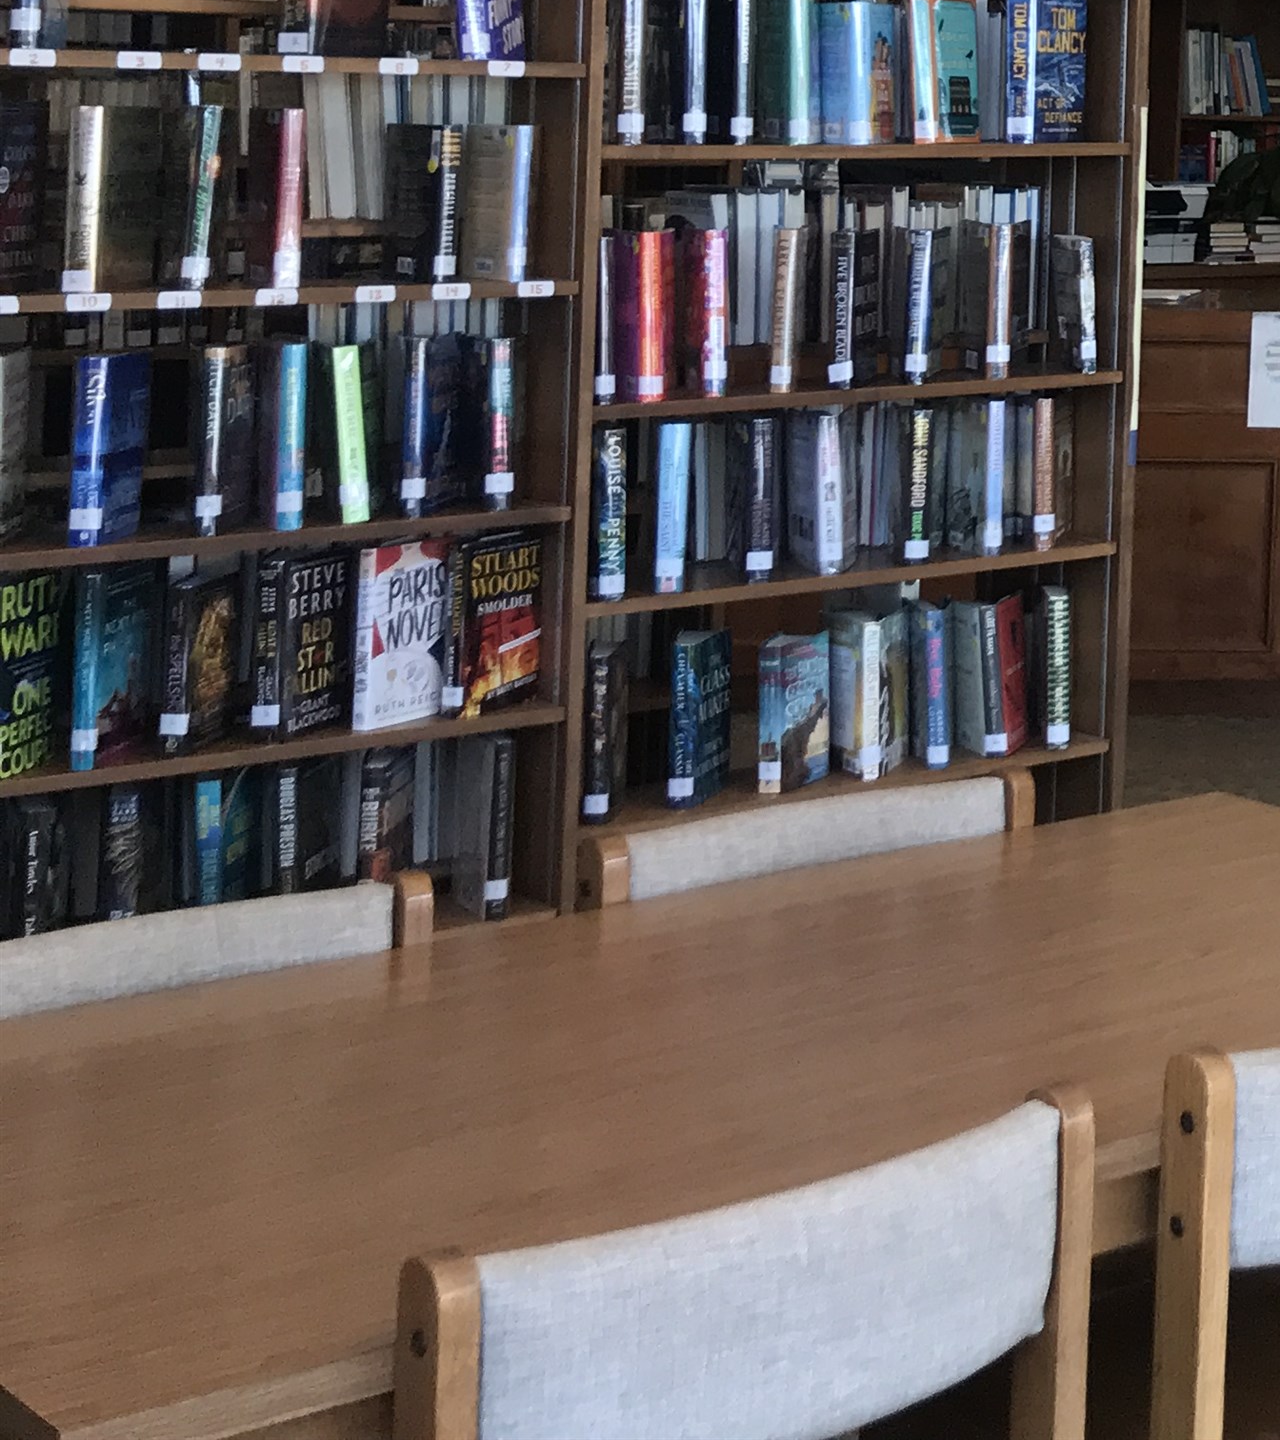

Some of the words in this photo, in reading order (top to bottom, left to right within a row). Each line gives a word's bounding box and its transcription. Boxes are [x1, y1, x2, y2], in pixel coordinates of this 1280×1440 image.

[1013, 1, 1029, 28] TOM
[1051, 7, 1077, 30] TOM
[623, 23, 640, 58] JANE
[1012, 30, 1028, 81] CLANCY
[1036, 30, 1087, 54] CLANCY
[622, 59, 640, 112] SMILEY
[1037, 97, 1052, 109] ACT
[1044, 111, 1083, 124] DEFIANCE
[442, 127, 462, 166] JAMES
[439, 220, 454, 257] EVERET
[776, 239, 790, 267] LARK
[836, 256, 848, 280] FIVE
[82, 295, 98, 307] 10
[271, 293, 284, 305] 12
[445, 285, 458, 296] 14
[530, 283, 543, 294] 15
[834, 282, 848, 327] BROKEN
[834, 329, 847, 364] BLADE
[205, 402, 216, 440] DARK
[912, 416, 930, 447] JOHN
[607, 436, 622, 495] LOUISE
[911, 448, 928, 508] SANDFORD
[911, 510, 925, 532] TOXIC
[606, 517, 622, 571] PENNY
[291, 561, 346, 594] STEVE
[470, 545, 541, 578] STUART
[389, 562, 447, 613] PARIS
[471, 566, 541, 600] WOODS
[288, 586, 346, 621] BERRY
[477, 593, 533, 616] SMOLDER
[302, 617, 332, 645] RED
[387, 599, 446, 651] NOVEL
[866, 629, 879, 647] ALL
[866, 648, 879, 684] FOURS
[13, 675, 51, 716] ONE
[299, 693, 330, 713] GRANT
[375, 697, 405, 714] RUTH
[279, 776, 295, 822] DOUGLAS
[360, 800, 380, 852] BURKE
[279, 824, 295, 868] PRESTON
